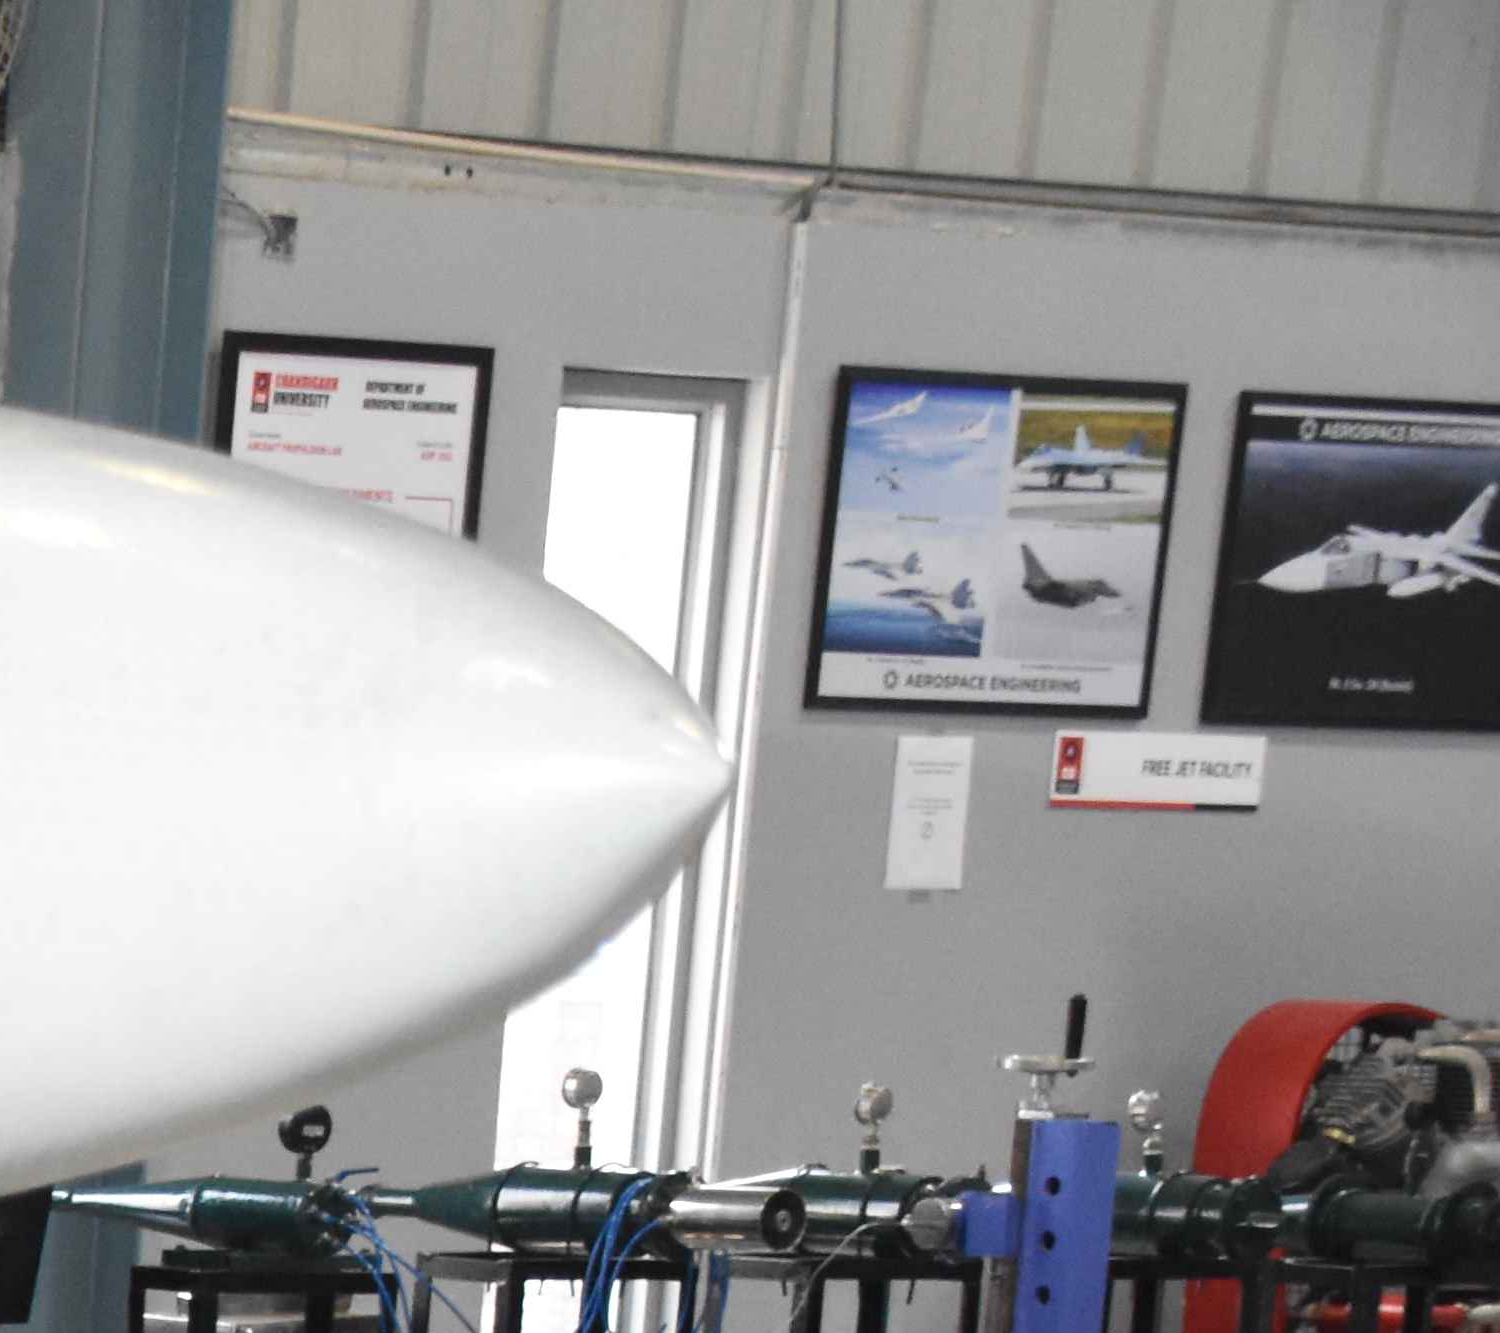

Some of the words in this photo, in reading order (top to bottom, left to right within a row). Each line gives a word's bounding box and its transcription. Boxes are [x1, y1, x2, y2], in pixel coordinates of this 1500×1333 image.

[273, 391, 330, 408] UNIVERSITY
[1320, 421, 1406, 443] AEROSPACE
[904, 673, 986, 691] AEROSPACE
[990, 675, 1082, 694] ENGINEERING
[1140, 759, 1172, 777] FREE
[1175, 761, 1197, 777] JET
[1199, 761, 1254, 778] FACILITY
